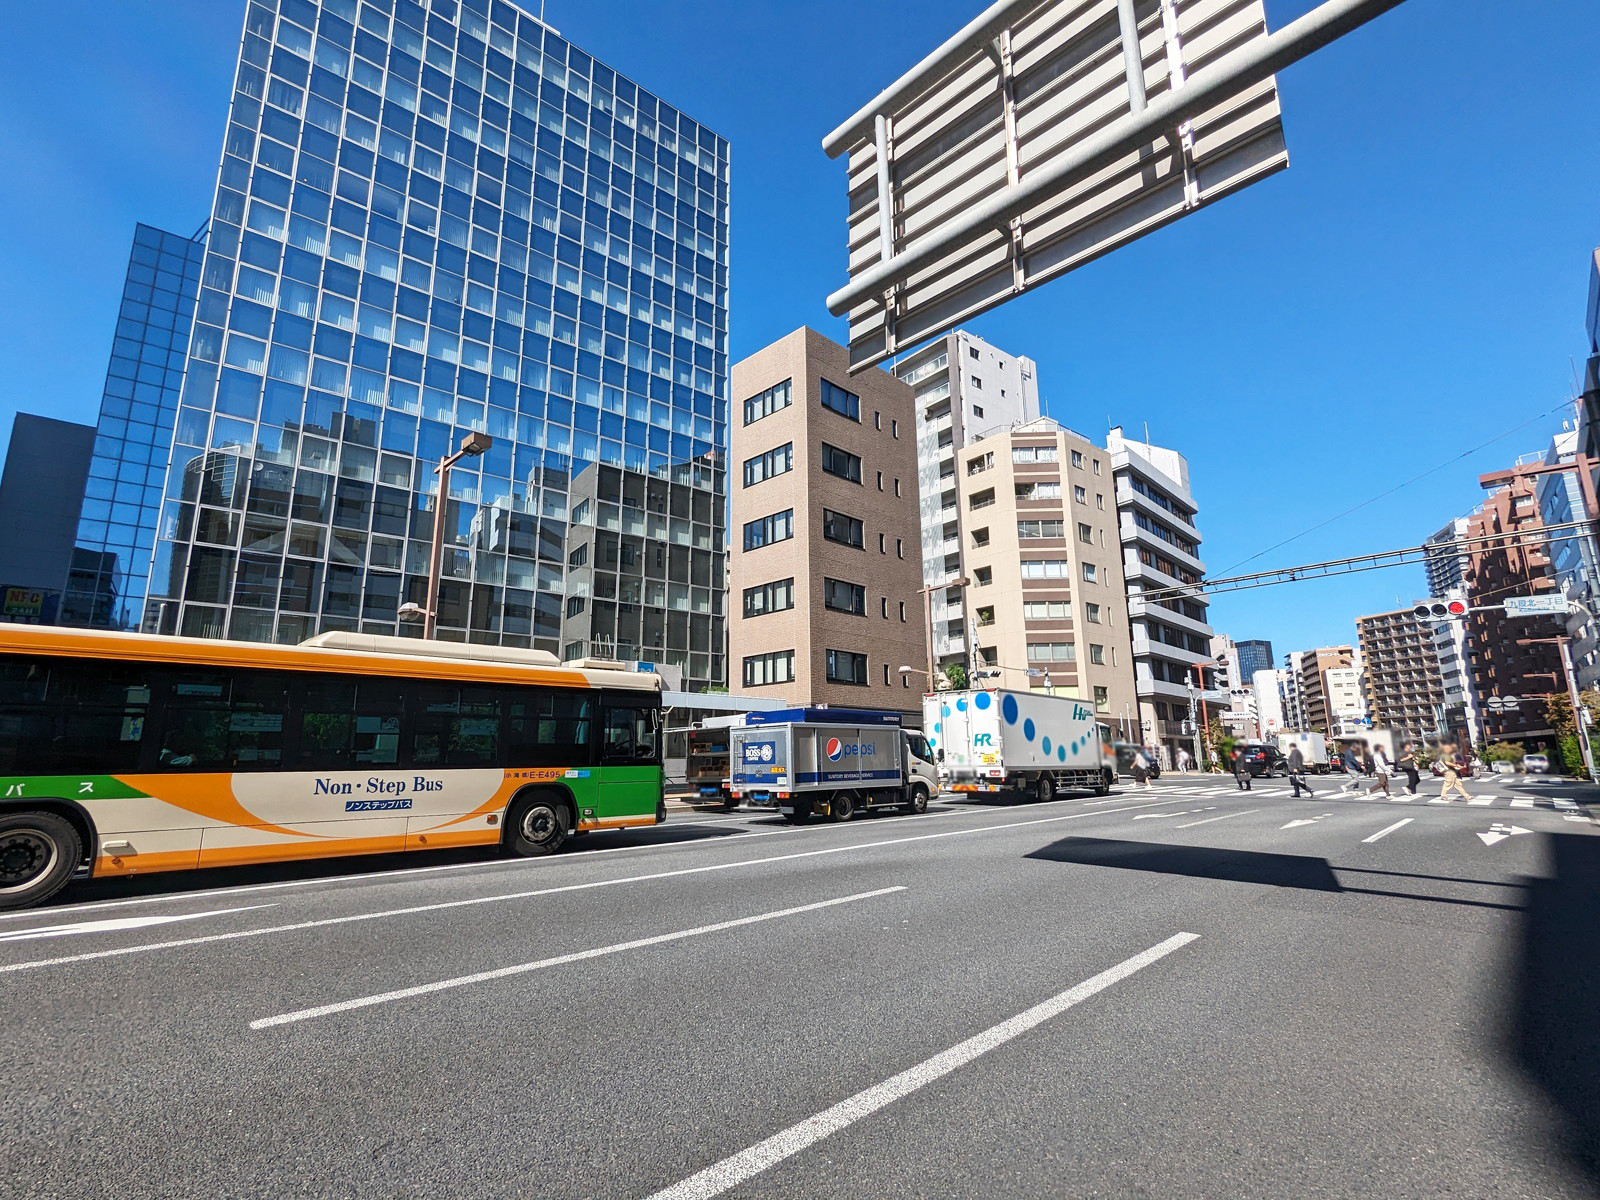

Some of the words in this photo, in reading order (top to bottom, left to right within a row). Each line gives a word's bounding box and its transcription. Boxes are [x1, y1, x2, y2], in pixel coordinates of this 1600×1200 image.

[1509, 596, 1563, 608] 九段北一丁目
[974, 733, 992, 746] HR
[745, 749, 761, 757] BOSS
[844, 742, 876, 758] pepsi
[412, 776, 443, 792] Bus
[346, 800, 412, 811] ノンステップバス
